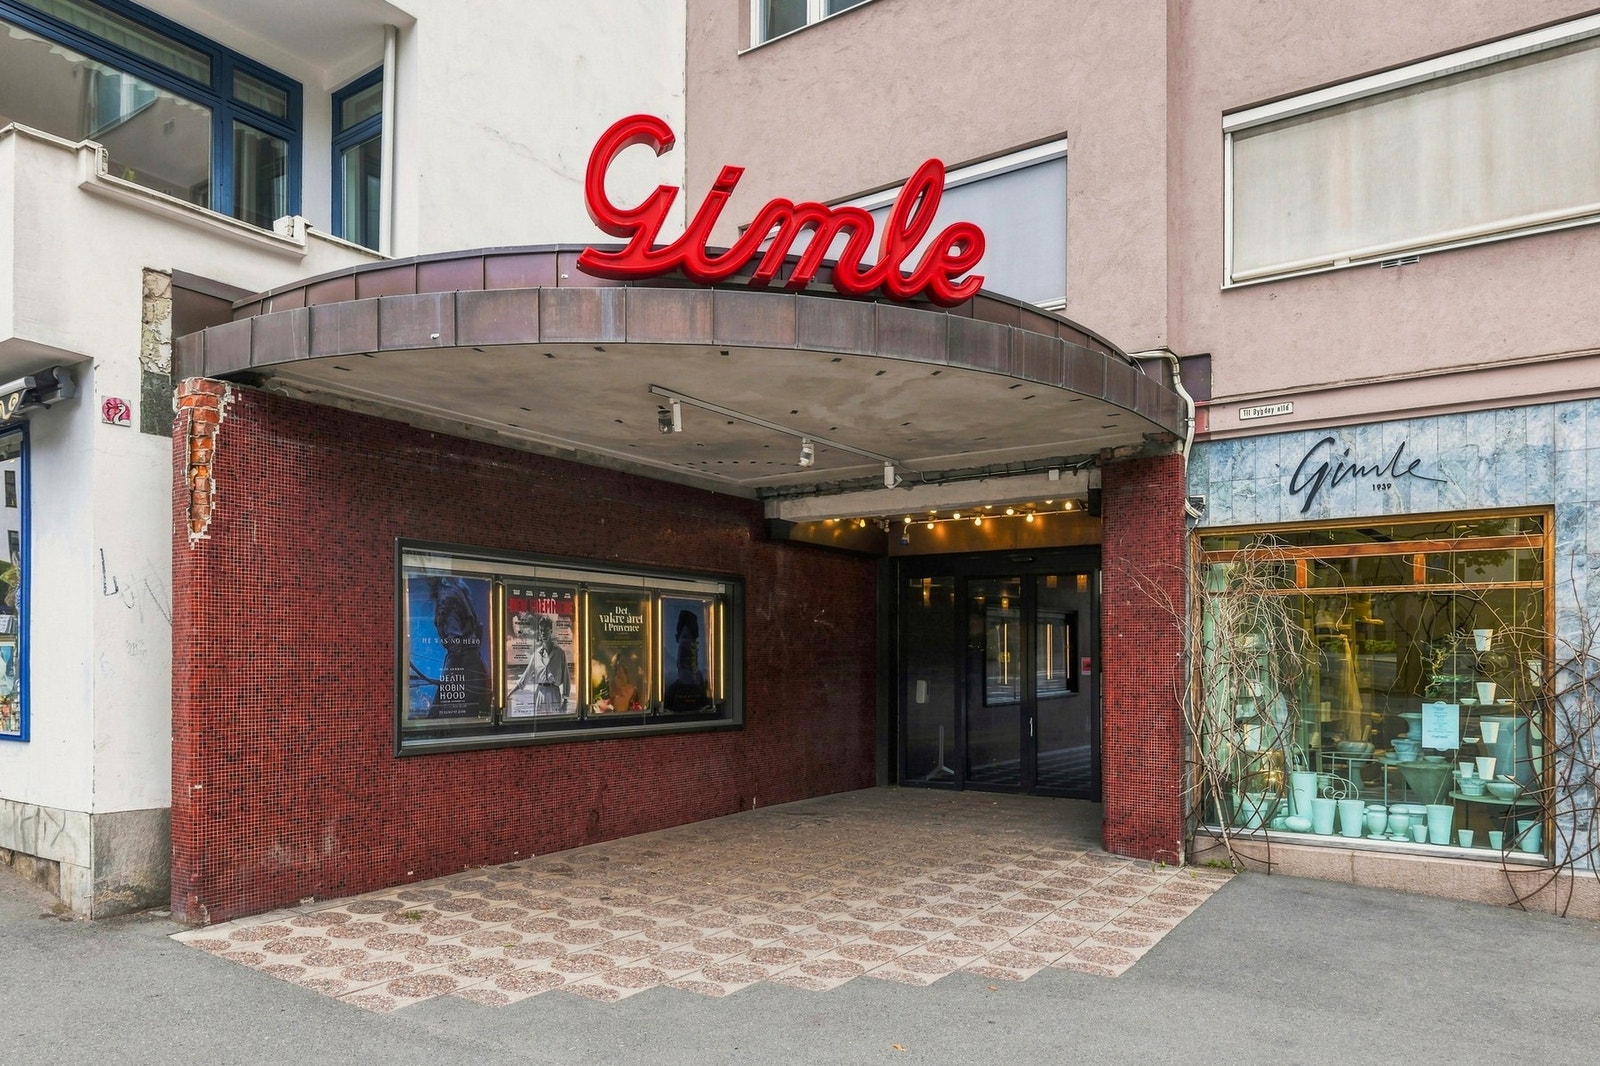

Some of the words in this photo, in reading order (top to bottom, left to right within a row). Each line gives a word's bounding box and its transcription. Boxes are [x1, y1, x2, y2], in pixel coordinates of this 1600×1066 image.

[576, 113, 986, 308] Gimle
[1243, 409, 1251, 417] Til
[1289, 436, 1448, 513] Gimle
[1372, 482, 1392, 491] 1939
[615, 606, 628, 615] Det
[599, 612, 625, 624] vakre
[608, 623, 640, 632] Provence
[440, 674, 465, 682] DEATH
[440, 684, 465, 692] ROBIN
[440, 691, 466, 700] HOOD
